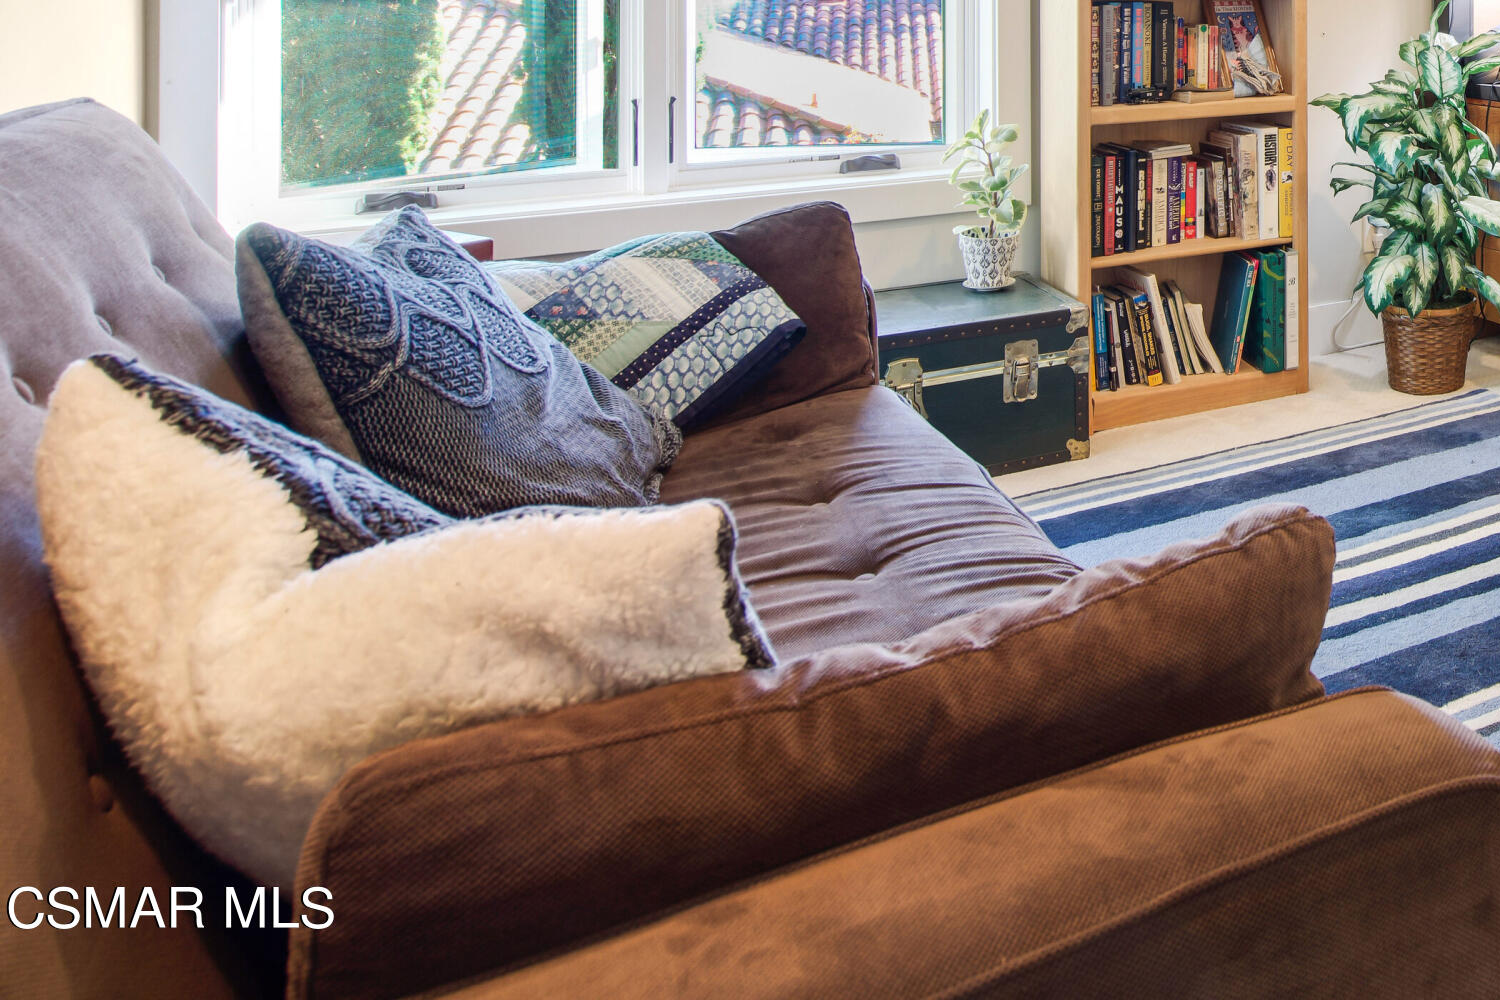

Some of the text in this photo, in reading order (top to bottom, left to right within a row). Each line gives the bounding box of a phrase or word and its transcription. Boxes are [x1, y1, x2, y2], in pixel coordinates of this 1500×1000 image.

[1264, 134, 1277, 166] HISTORY
[1115, 184, 1124, 227] MAUS
[1137, 170, 1146, 231] ROMMEL
[1172, 196, 1180, 229] AMERICA
[1217, 179, 1225, 217] PACIFIC
